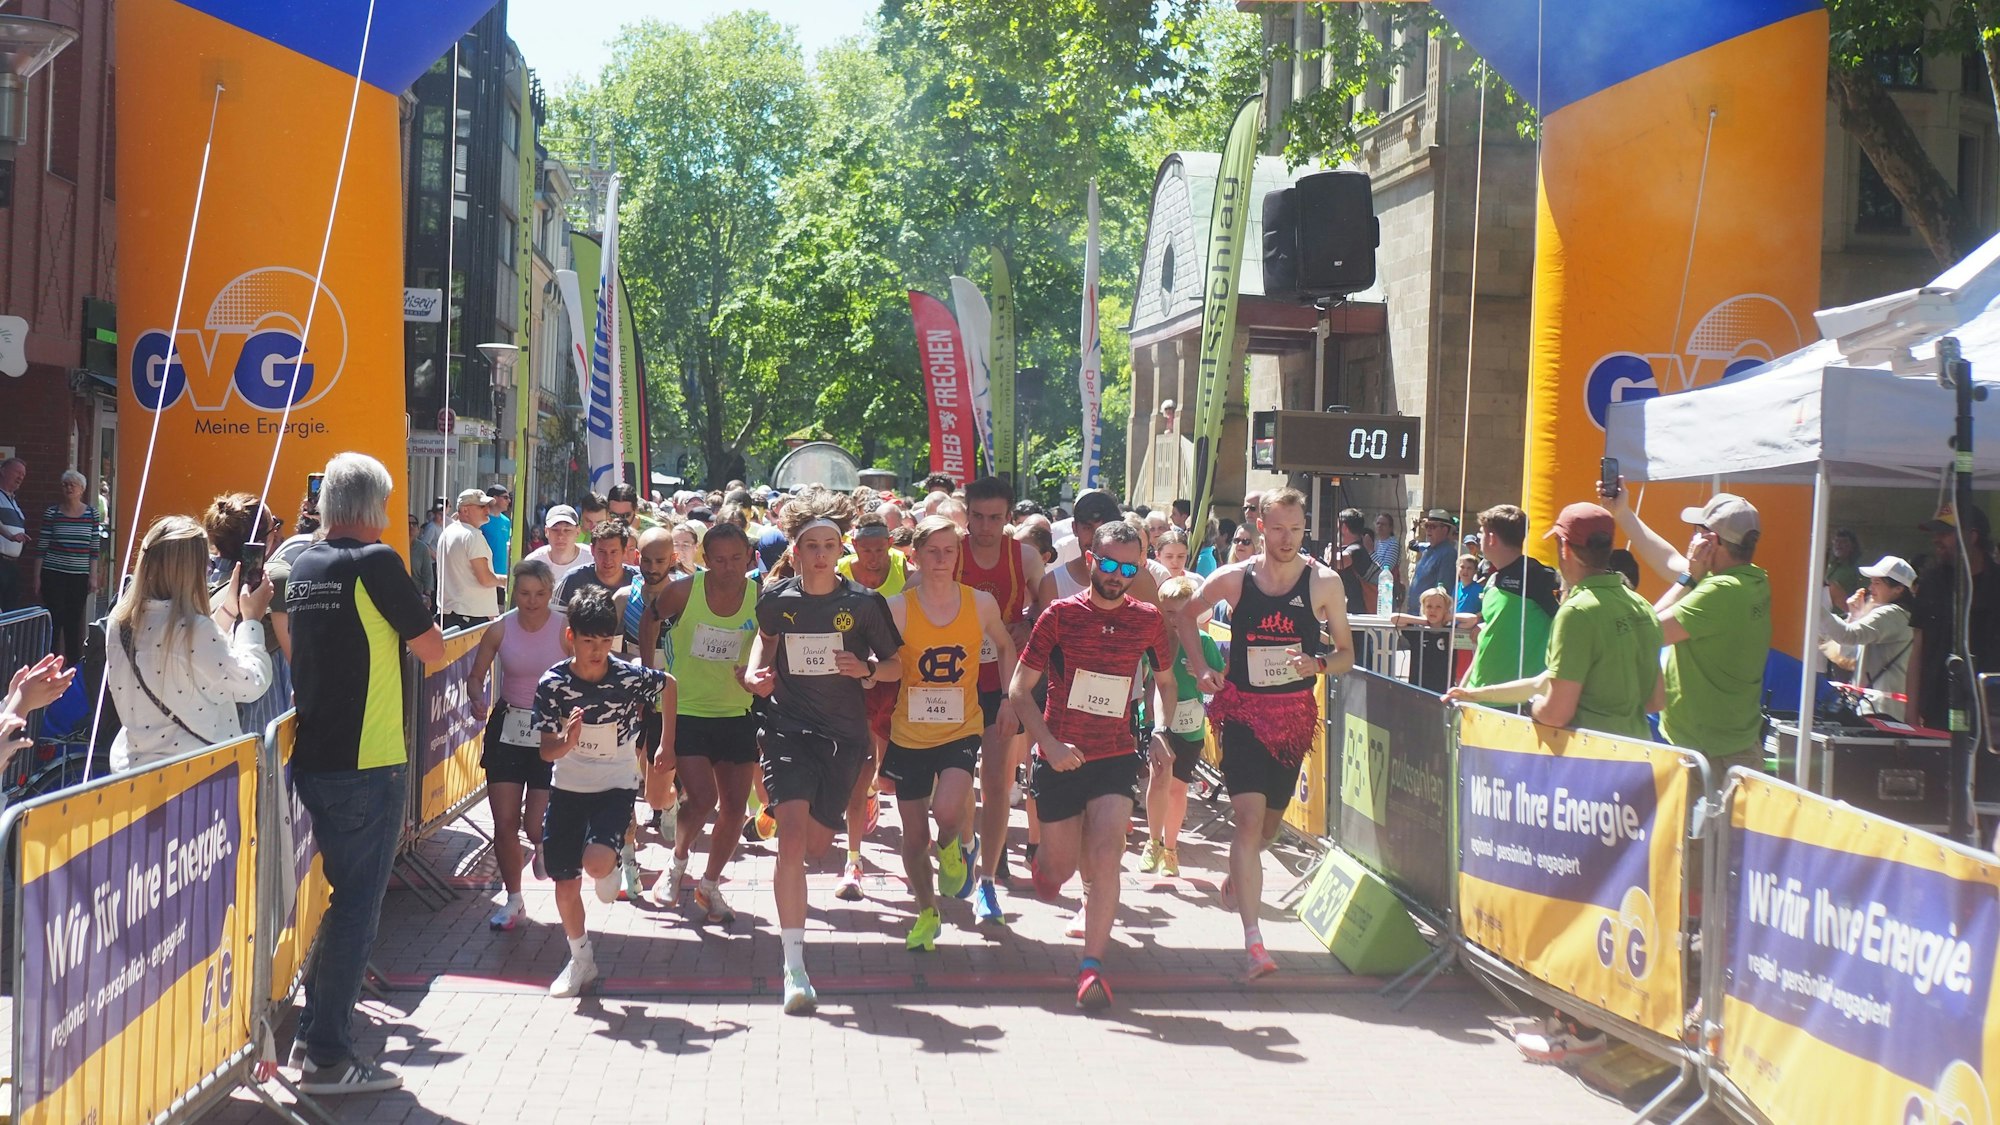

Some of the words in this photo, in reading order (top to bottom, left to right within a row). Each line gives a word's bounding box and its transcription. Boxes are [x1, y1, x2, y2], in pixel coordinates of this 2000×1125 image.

[130, 328, 314, 413] GVG
[926, 329, 958, 407] FRECHEN
[1085, 370, 1095, 397] Der
[194, 418, 250, 434] Meine
[256, 418, 330, 439] Energie.
[836, 614, 851, 626] BVB
[706, 645, 727, 654] 1389
[803, 646, 828, 656] Daniel
[806, 657, 825, 665] 662
[1264, 667, 1288, 677] 1062
[926, 706, 946, 714] 448
[1087, 695, 1110, 706] 1292
[1179, 718, 1194, 726] 233
[1390, 753, 1444, 817] pulsschlag
[1470, 775, 1492, 817] Wir
[1492, 776, 1513, 822] für
[1515, 781, 1549, 829] Ihre
[1553, 787, 1646, 847] Energie.
[1537, 853, 1582, 876] engagiert
[46, 902, 91, 987] Wir
[94, 880, 121, 954] für
[127, 862, 162, 929] Ihre
[166, 809, 233, 899] Energie.
[1813, 887, 1865, 956] Ihre
[1862, 901, 1973, 996] Energie.
[51, 993, 89, 1051] regional
[97, 951, 146, 1017] persönlich
[152, 918, 187, 970] engagiert
